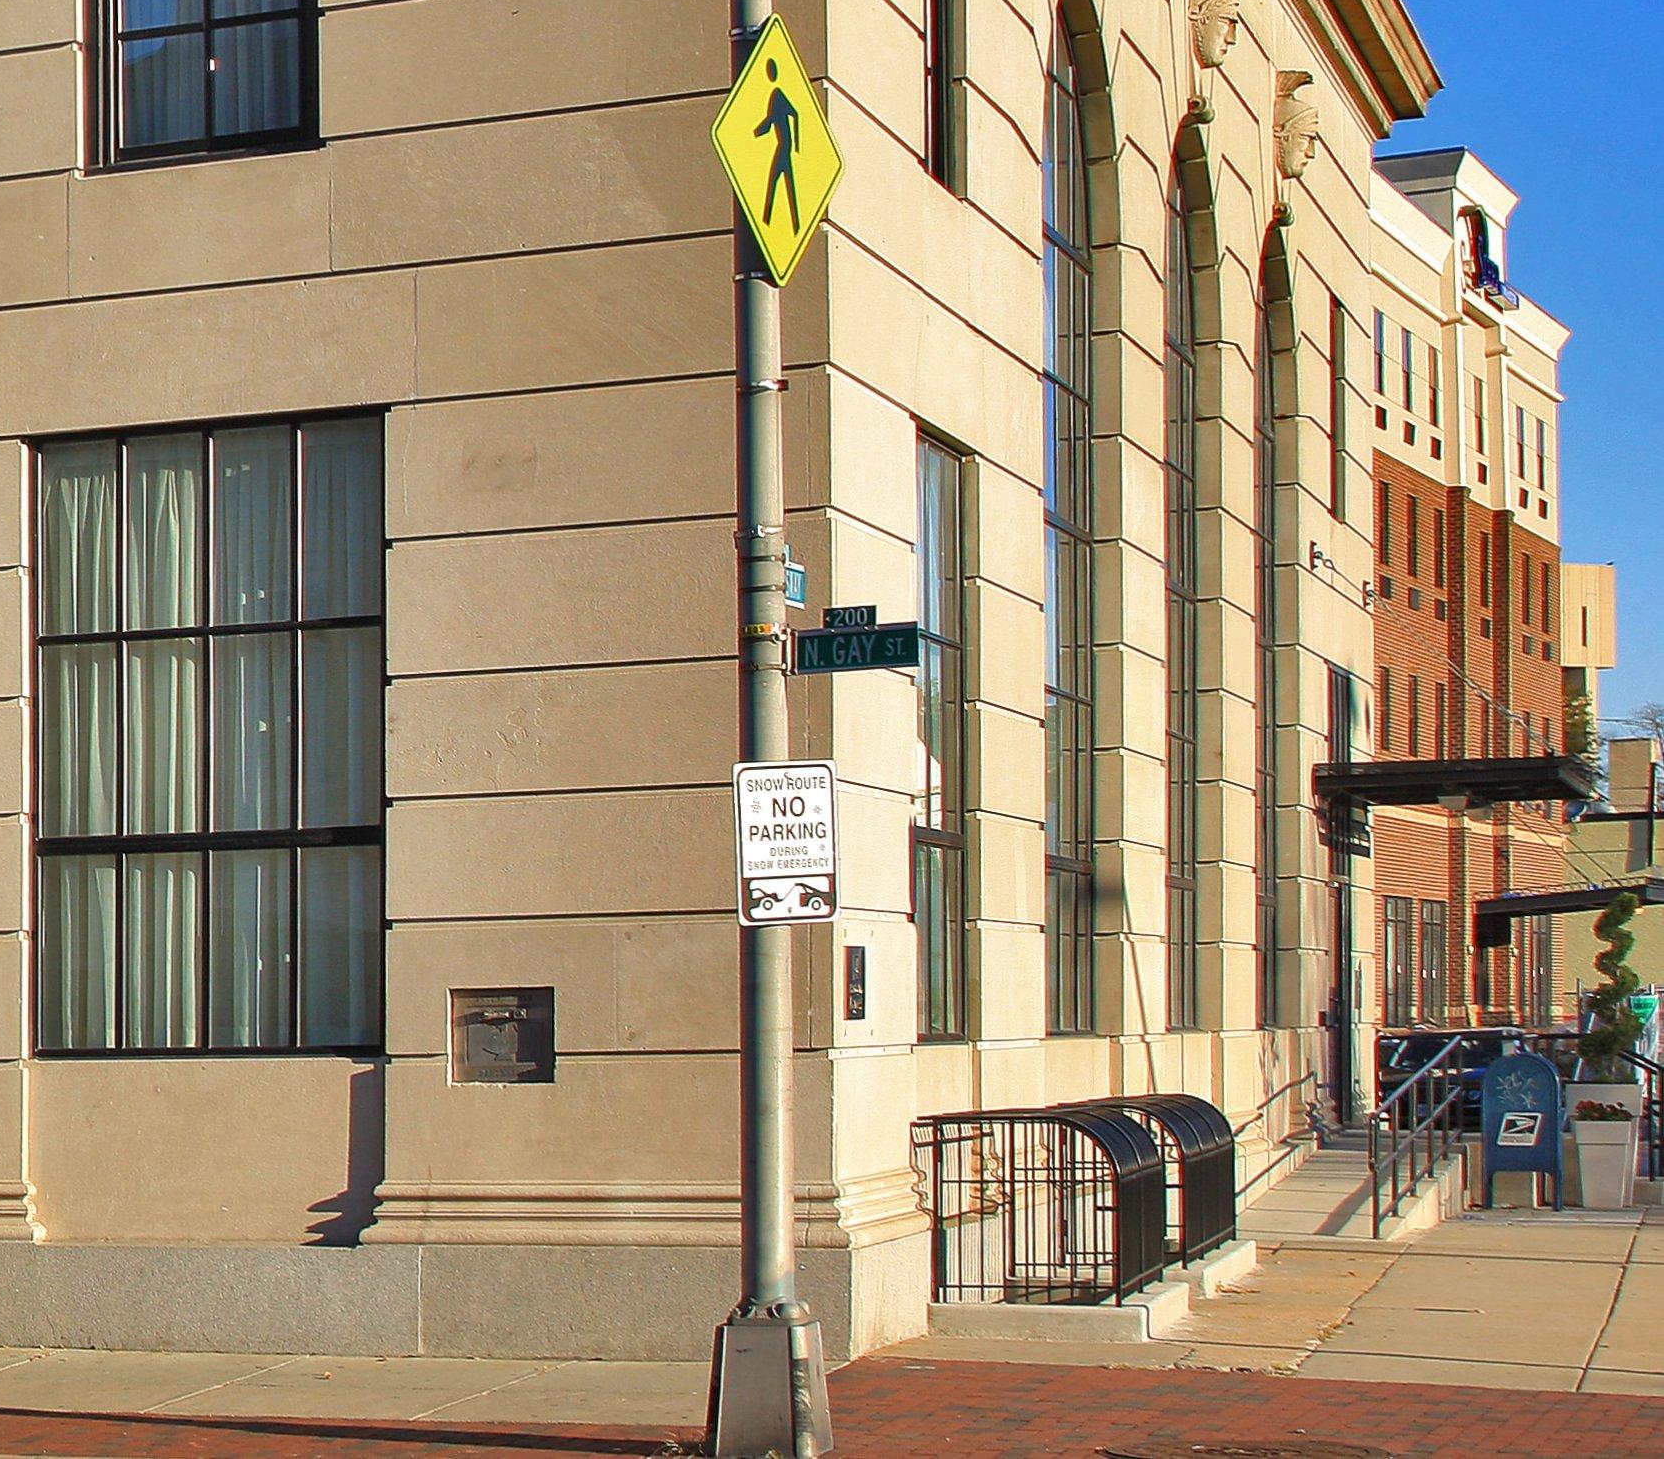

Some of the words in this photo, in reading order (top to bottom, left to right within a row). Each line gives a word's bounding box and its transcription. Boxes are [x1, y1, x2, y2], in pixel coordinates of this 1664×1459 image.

[833, 607, 869, 627] 200
[804, 638, 824, 667] N.
[832, 634, 877, 665] GAY
[746, 778, 784, 792] SNOW
[787, 776, 827, 790] ROUTE
[772, 796, 805, 818] NO
[749, 822, 827, 841] PARKING
[770, 846, 809, 857] DURING
[747, 860, 773, 871] SNOW
[777, 857, 829, 870] EMERGENCY
